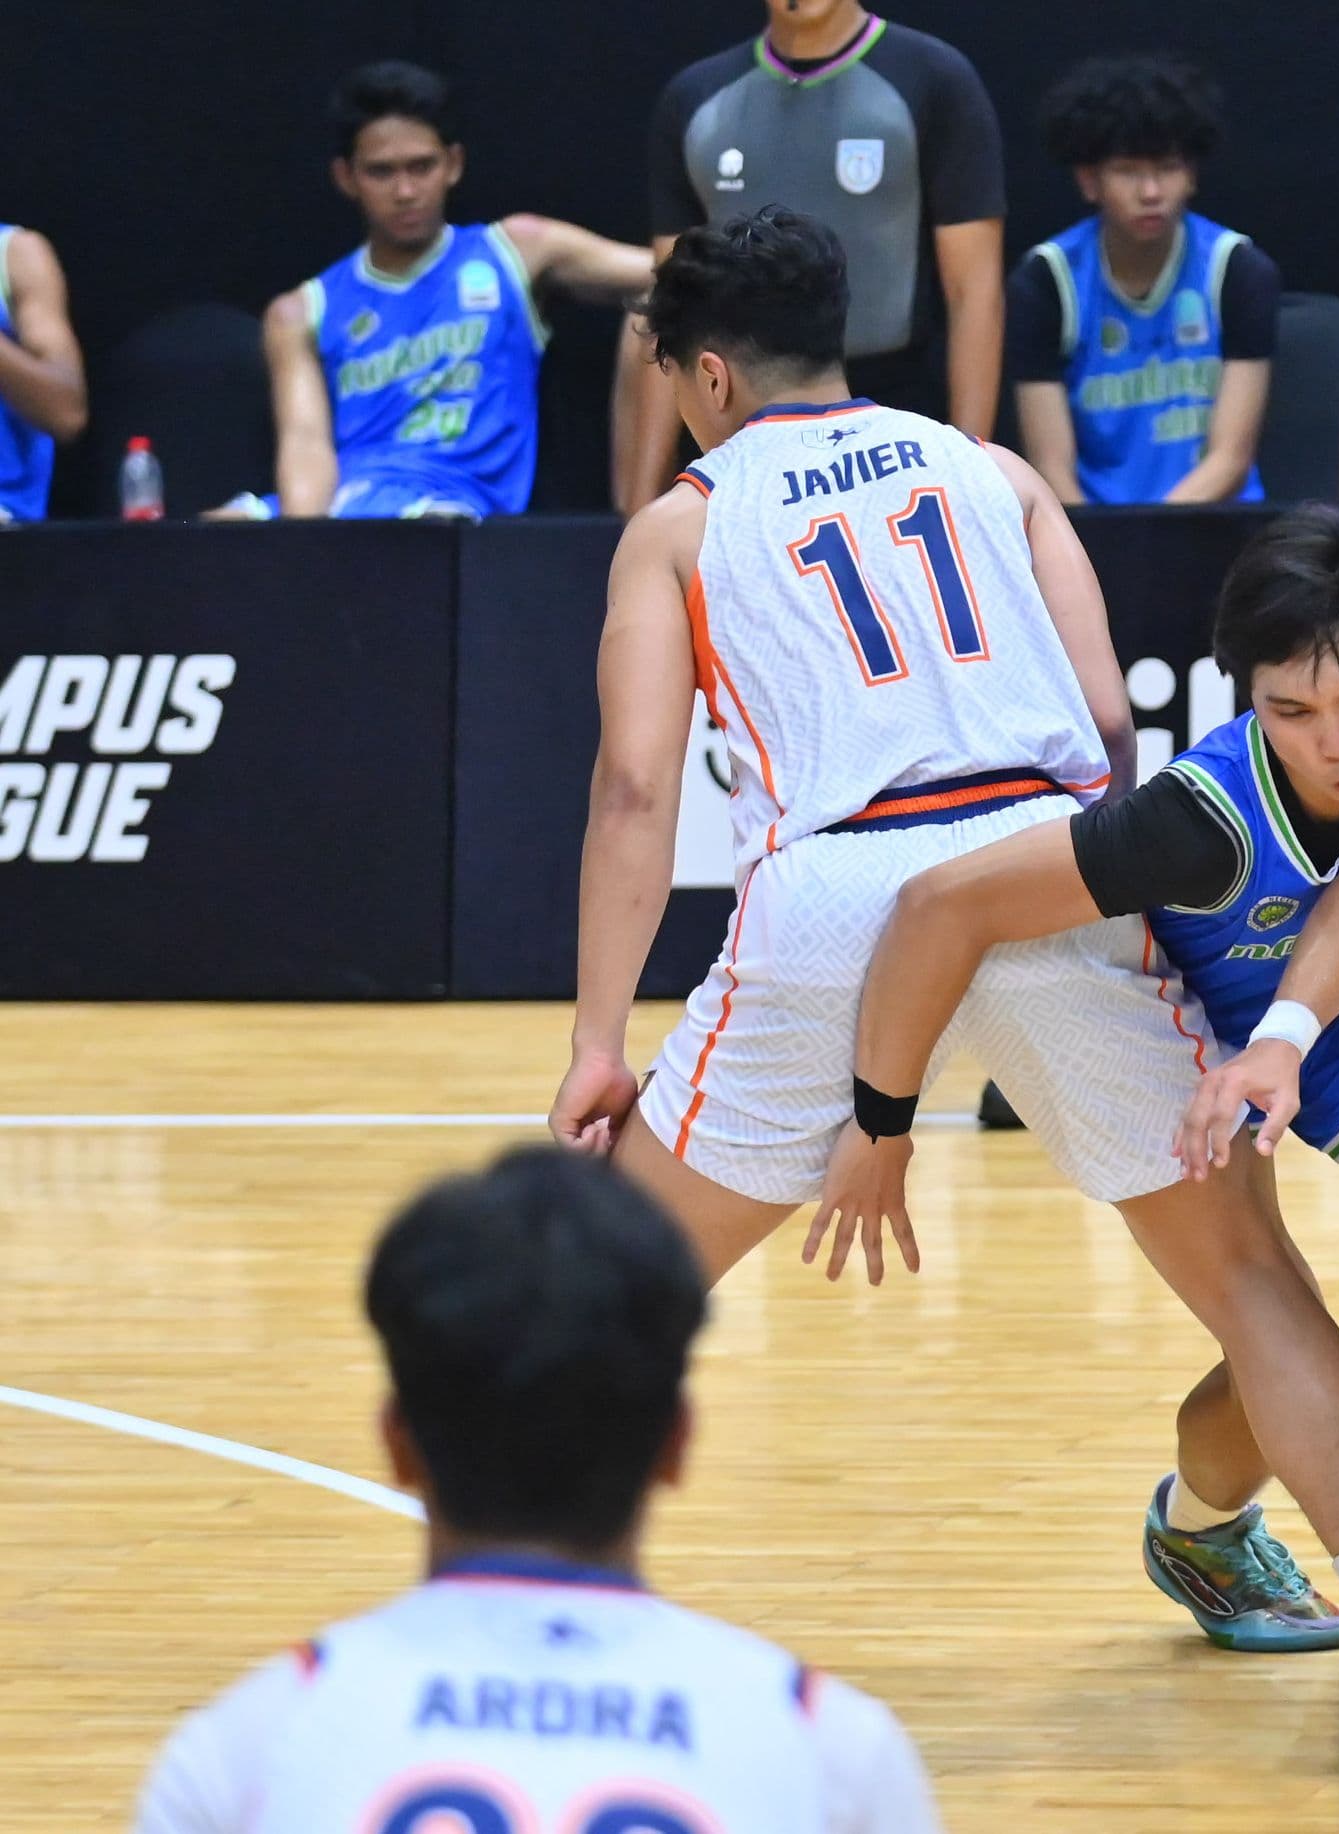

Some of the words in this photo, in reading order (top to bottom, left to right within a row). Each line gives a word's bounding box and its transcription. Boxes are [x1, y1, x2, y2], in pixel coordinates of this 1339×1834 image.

[782, 439, 928, 506] JAVIER
[786, 486, 991, 688] 11
[414, 1671, 695, 1754] ARDRA
